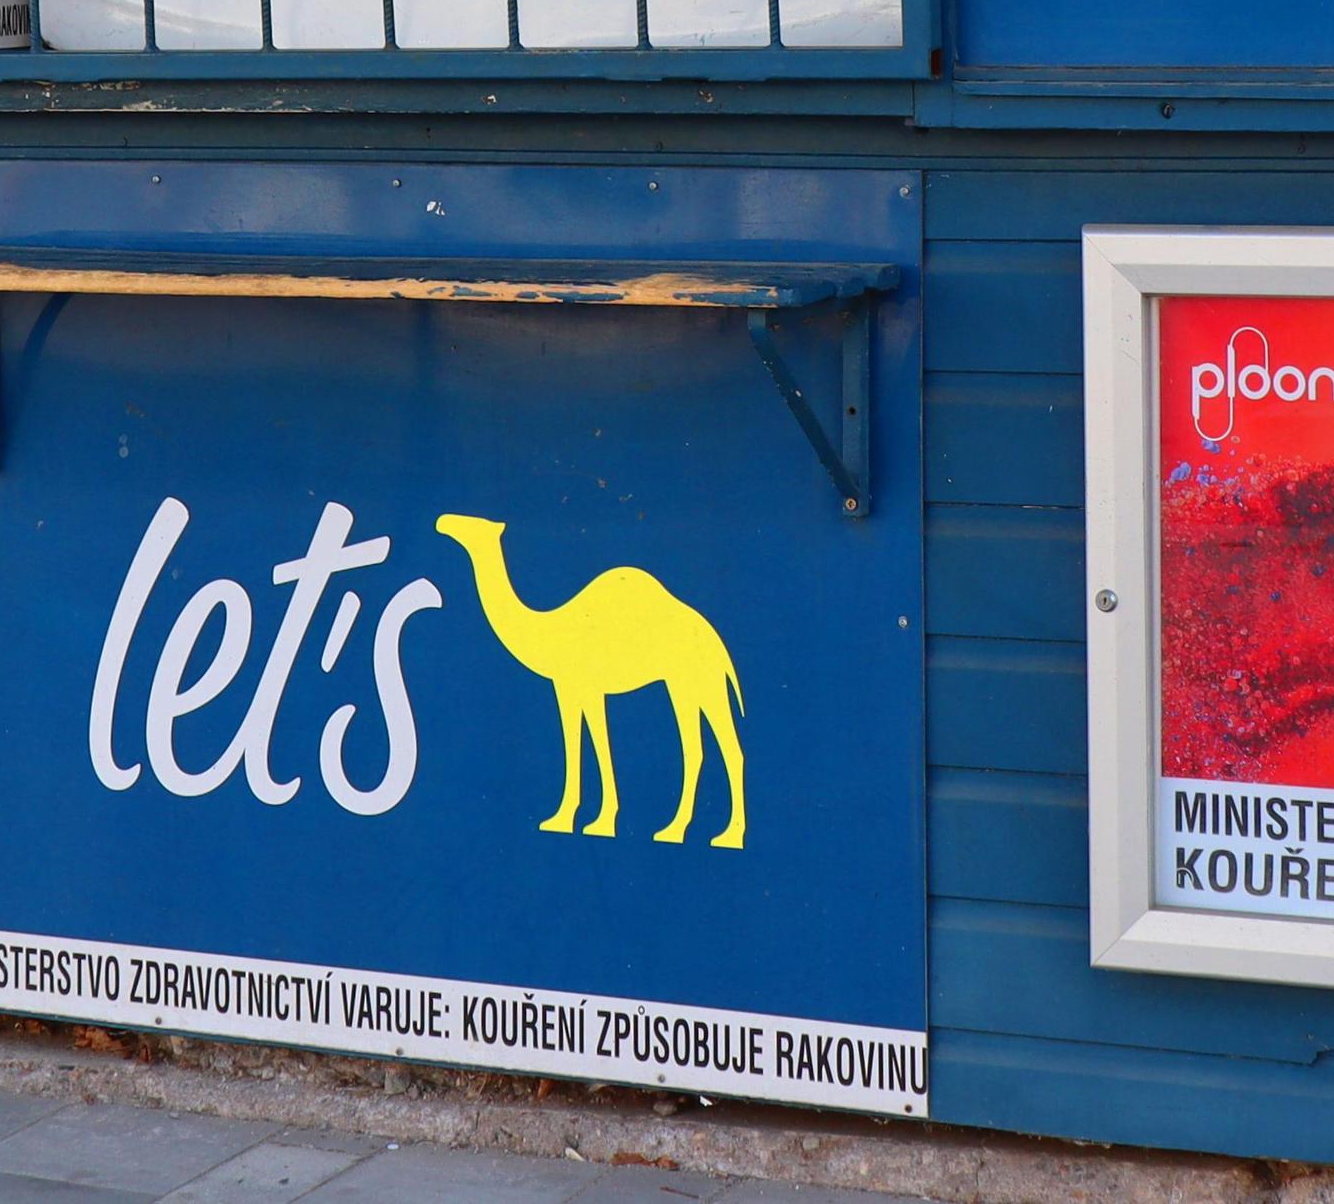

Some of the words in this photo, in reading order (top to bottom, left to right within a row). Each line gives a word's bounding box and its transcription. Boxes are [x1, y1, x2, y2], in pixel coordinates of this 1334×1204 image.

[88, 496, 443, 816] let's
[129, 958, 332, 1025] ZDRAVOTNICTVÍ
[340, 982, 450, 1039] VARUJE:
[463, 992, 589, 1055] KOUŘENÍ
[596, 1005, 765, 1075] ZPŮSOBUJE
[776, 1030, 927, 1095] RAKOVINU
